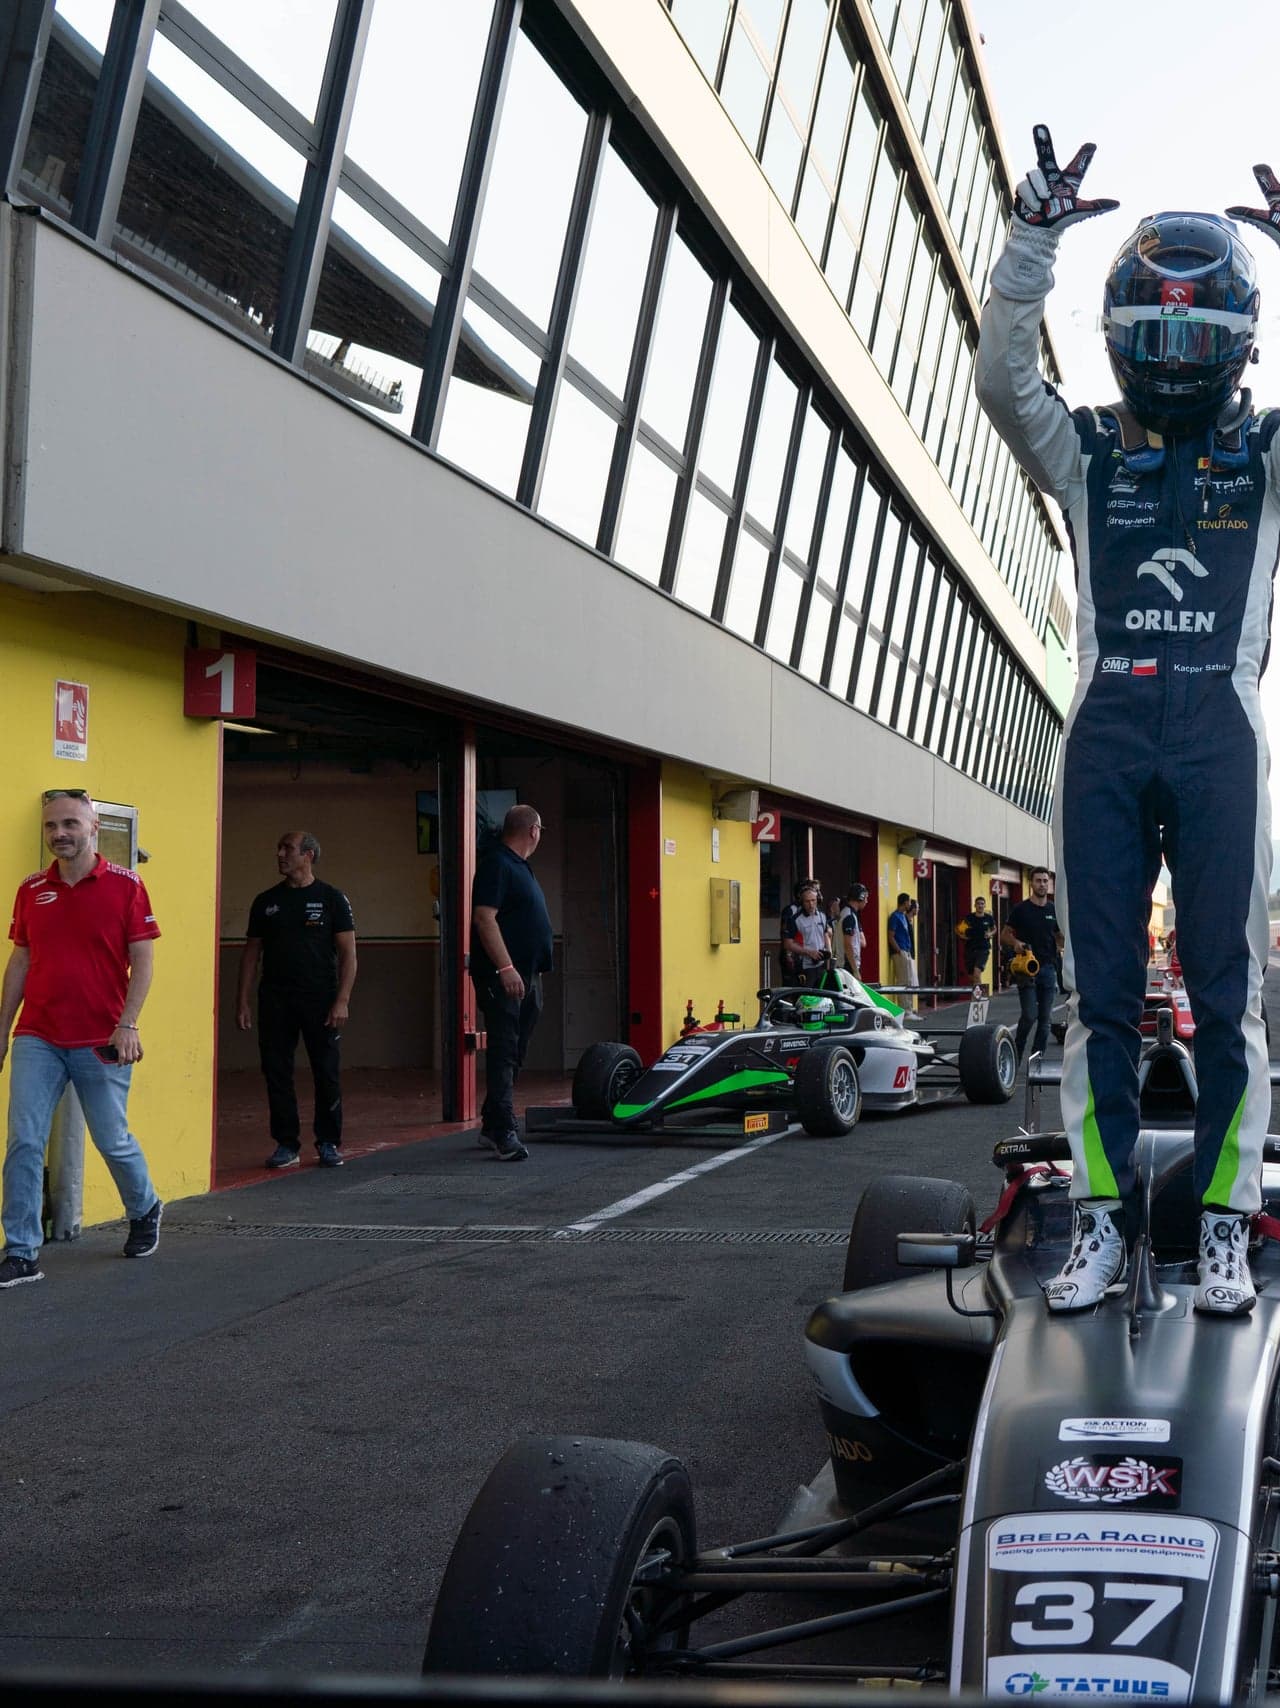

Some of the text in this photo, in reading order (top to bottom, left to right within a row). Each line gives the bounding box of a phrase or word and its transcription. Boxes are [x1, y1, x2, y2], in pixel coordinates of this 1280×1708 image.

[1197, 520, 1248, 529] TENUTADO
[1125, 609, 1216, 633] ORLEN
[1102, 659, 1130, 671] OMP
[1174, 663, 1202, 674] Kacper
[206, 653, 235, 713] 1
[757, 812, 776, 840] 2
[916, 859, 928, 878] 3
[992, 882, 1001, 894] 4
[973, 1003, 984, 1023] 31
[664, 1054, 695, 1063] 31
[1001, 1143, 1031, 1154] EXTRAL
[1102, 1420, 1147, 1428] ACTION
[1063, 1466, 1178, 1496] WSK
[997, 1531, 1205, 1548] BREDA RACING
[996, 1548, 1034, 1556] racing
[1035, 1546, 1112, 1554] components
[1140, 1548, 1205, 1560] equipment
[1011, 1581, 1184, 1647] 37
[1055, 1677, 1169, 1696] TATUUS
